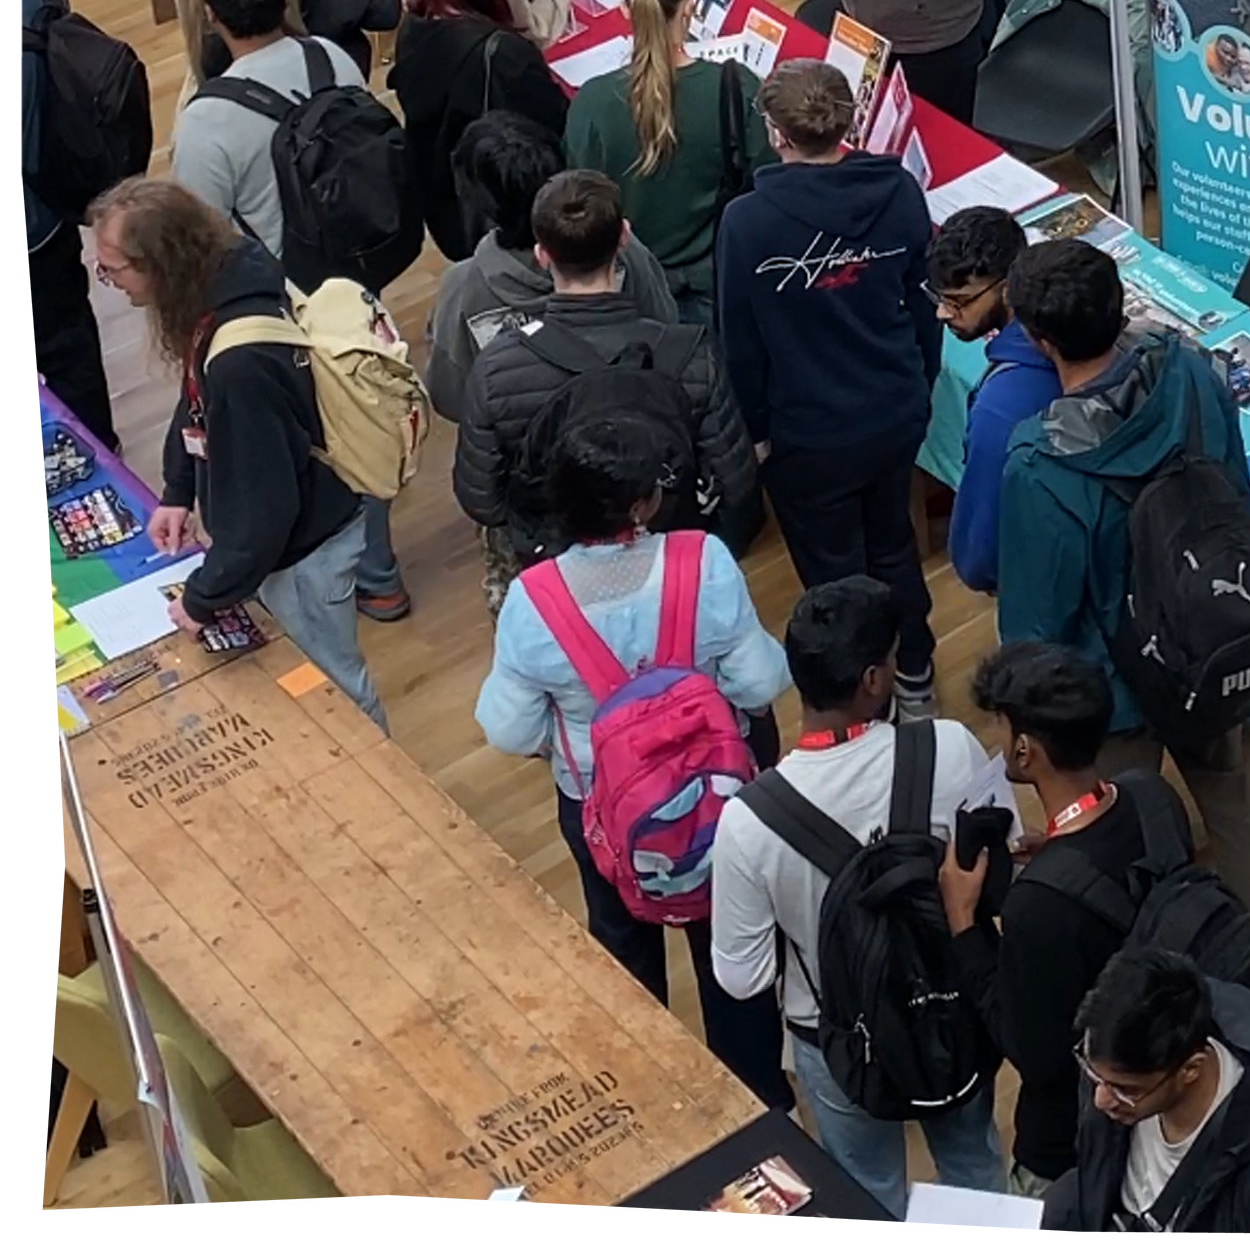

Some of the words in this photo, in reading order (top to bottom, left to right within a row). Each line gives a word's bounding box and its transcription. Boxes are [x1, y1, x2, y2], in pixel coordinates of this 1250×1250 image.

[1171, 161, 1190, 178] Our
[1172, 177, 1236, 210] experiences
[1172, 204, 1201, 226] helps
[1202, 215, 1222, 230] our
[1180, 194, 1198, 211] the
[1199, 202, 1227, 222] lives
[1228, 209, 1241, 224] of
[115, 707, 250, 792] MARQUEES
[127, 722, 275, 814] KINGSMEAD
[459, 1067, 621, 1173] KINGSMEAD
[488, 1094, 637, 1193] MARQUEES
